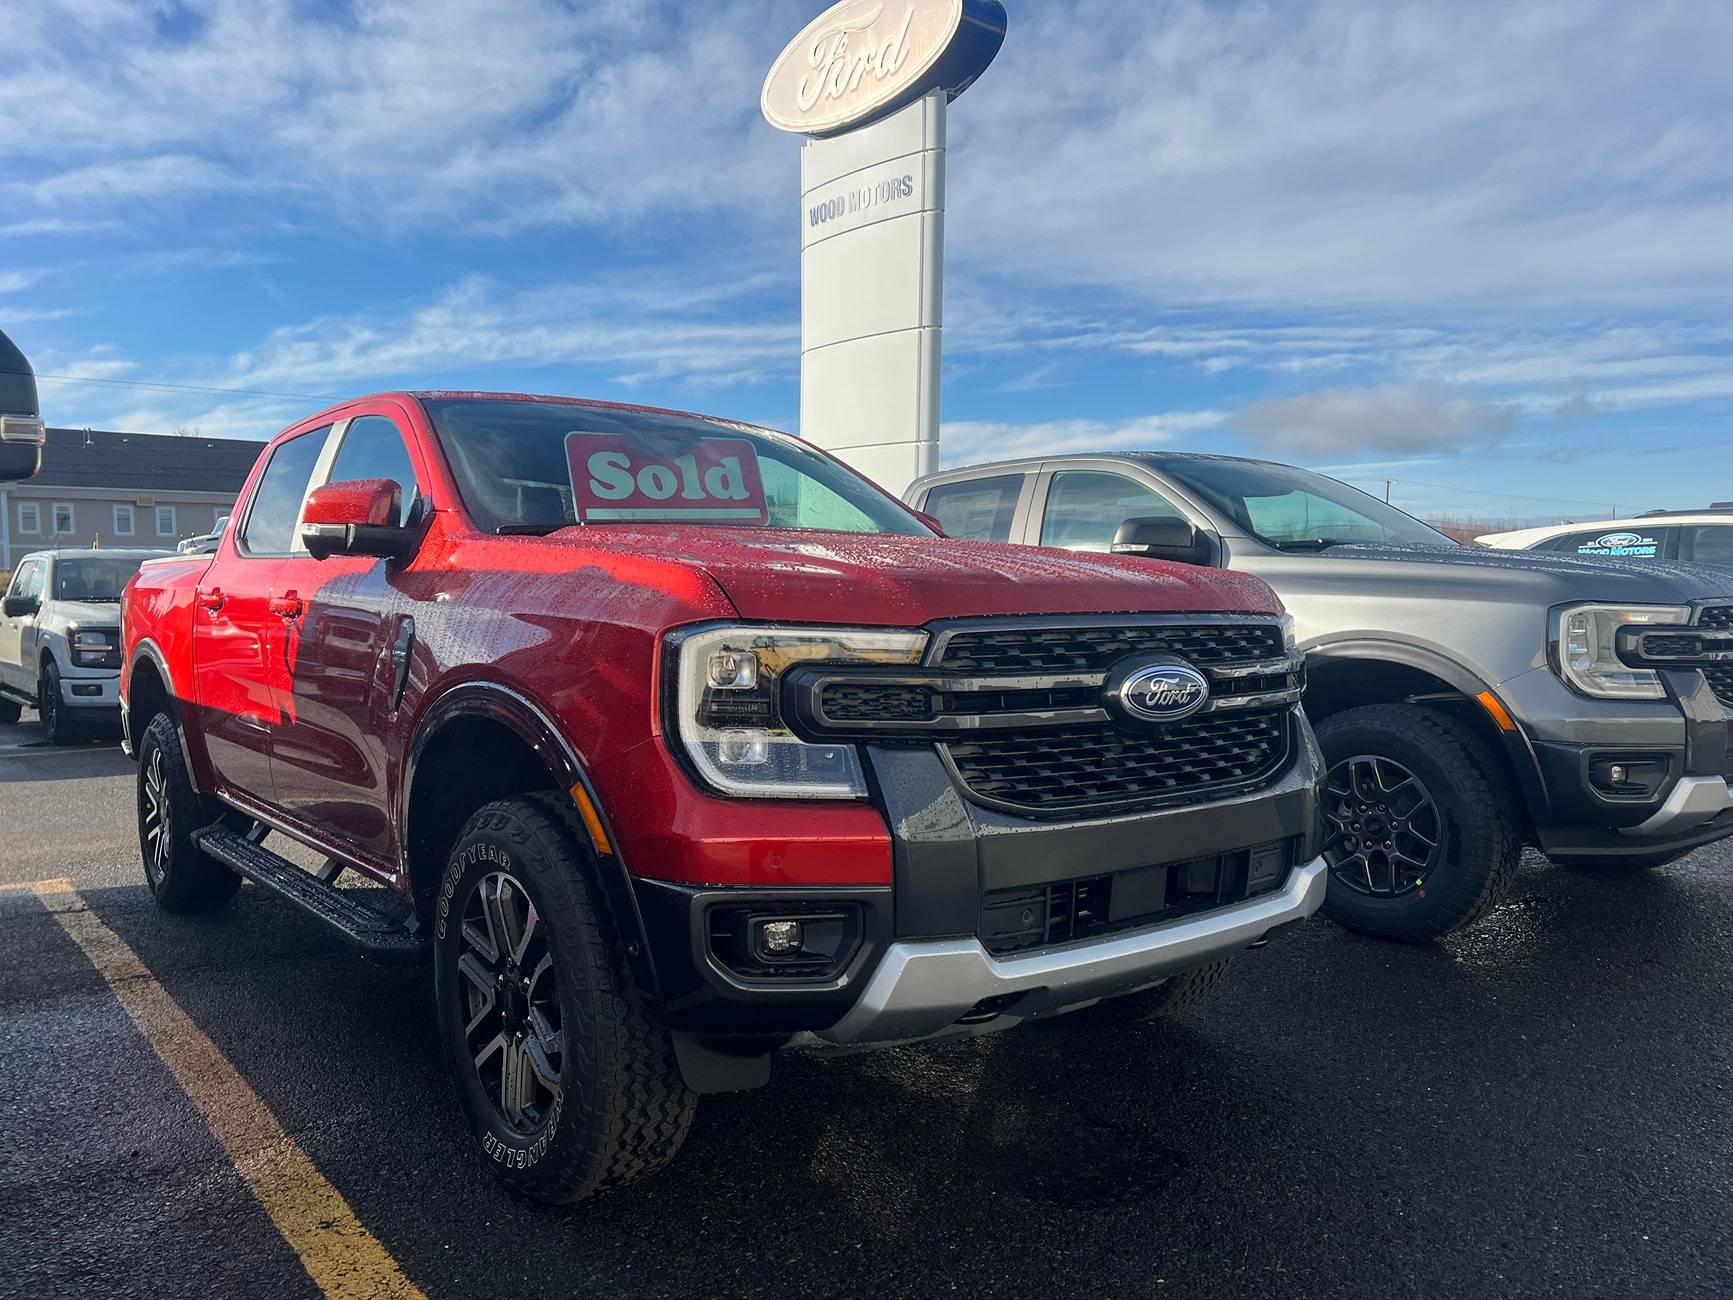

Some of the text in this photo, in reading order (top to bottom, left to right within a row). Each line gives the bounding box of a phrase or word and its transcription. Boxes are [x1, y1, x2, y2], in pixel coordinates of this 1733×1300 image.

[797, 3, 915, 112] Ford
[809, 175, 914, 227] WOOD MOTORS
[587, 451, 751, 500] Sold
[1610, 545, 1657, 556] MOTORS
[1145, 677, 1191, 707] Ford
[437, 843, 511, 940] GOODYEAR
